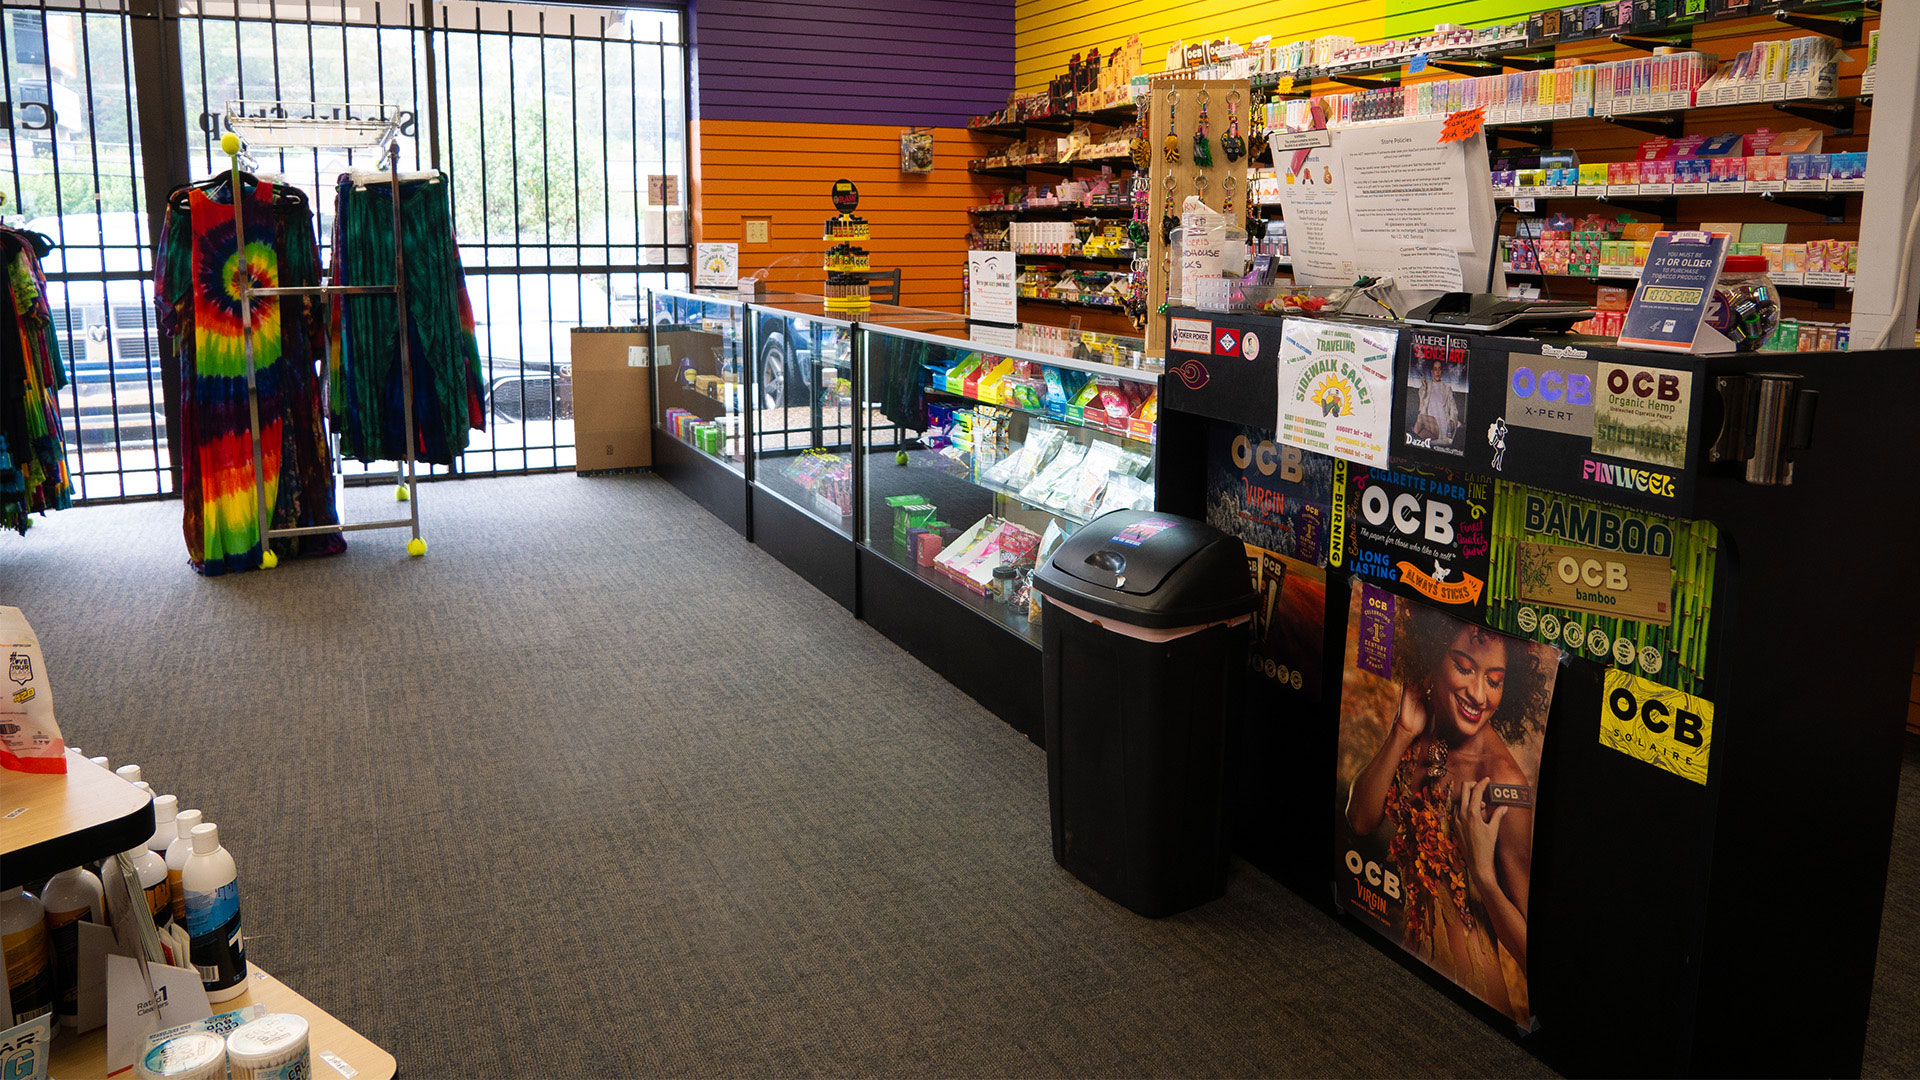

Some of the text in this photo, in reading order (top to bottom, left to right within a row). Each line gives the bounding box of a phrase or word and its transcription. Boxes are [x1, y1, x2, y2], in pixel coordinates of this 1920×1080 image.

[1655, 258, 1713, 268] 21 OR OLDER
[1677, 274, 1707, 282] PRODUCTS
[1316, 338, 1356, 354] TRAVELING
[1413, 334, 1468, 350] WHERE MEETS
[1448, 349, 1466, 363] ART
[1296, 359, 1371, 405] SIDEWALK SALE!
[1511, 366, 1593, 406] OCB
[1607, 368, 1680, 402] OCB
[1525, 406, 1574, 421] X-PERT
[1608, 394, 1676, 414] Organic Hemp
[1598, 423, 1680, 452] SOLD HERE
[1231, 434, 1303, 484] OCB
[1369, 467, 1466, 500] CIGARETTE PAPER
[1582, 459, 1676, 498] PINWEEL
[1241, 476, 1285, 516] VIRGIN
[1467, 483, 1488, 500] FINE
[1304, 504, 1319, 516] OCB
[1331, 458, 1346, 563] OW-BURNING
[1361, 485, 1455, 546] OCB
[1524, 494, 1674, 559] BAMBOO
[1360, 527, 1369, 538] The
[1369, 531, 1385, 543] paper
[1385, 534, 1395, 546] for
[1395, 539, 1409, 550] those
[1409, 542, 1421, 553] who
[1421, 545, 1432, 556] like
[1432, 549, 1440, 558] to
[1456, 534, 1489, 552] Quality
[1263, 557, 1282, 576] OCB
[1350, 560, 1397, 581] LASTING
[1359, 550, 1390, 566] LONG
[1405, 568, 1471, 602] ALWAYS STICKS
[1557, 556, 1630, 592] OCB
[1368, 597, 1388, 611] OCB
[1575, 588, 1616, 606] bamboo
[13, 687, 36, 703] 420
[1609, 688, 1703, 748] OCB
[1613, 728, 1693, 766] SOLAIRE
[1494, 788, 1519, 800] OCB
[1345, 850, 1401, 900] OCB
[1353, 877, 1387, 914] VIRGIN
[136, 997, 163, 1010] Ratd
